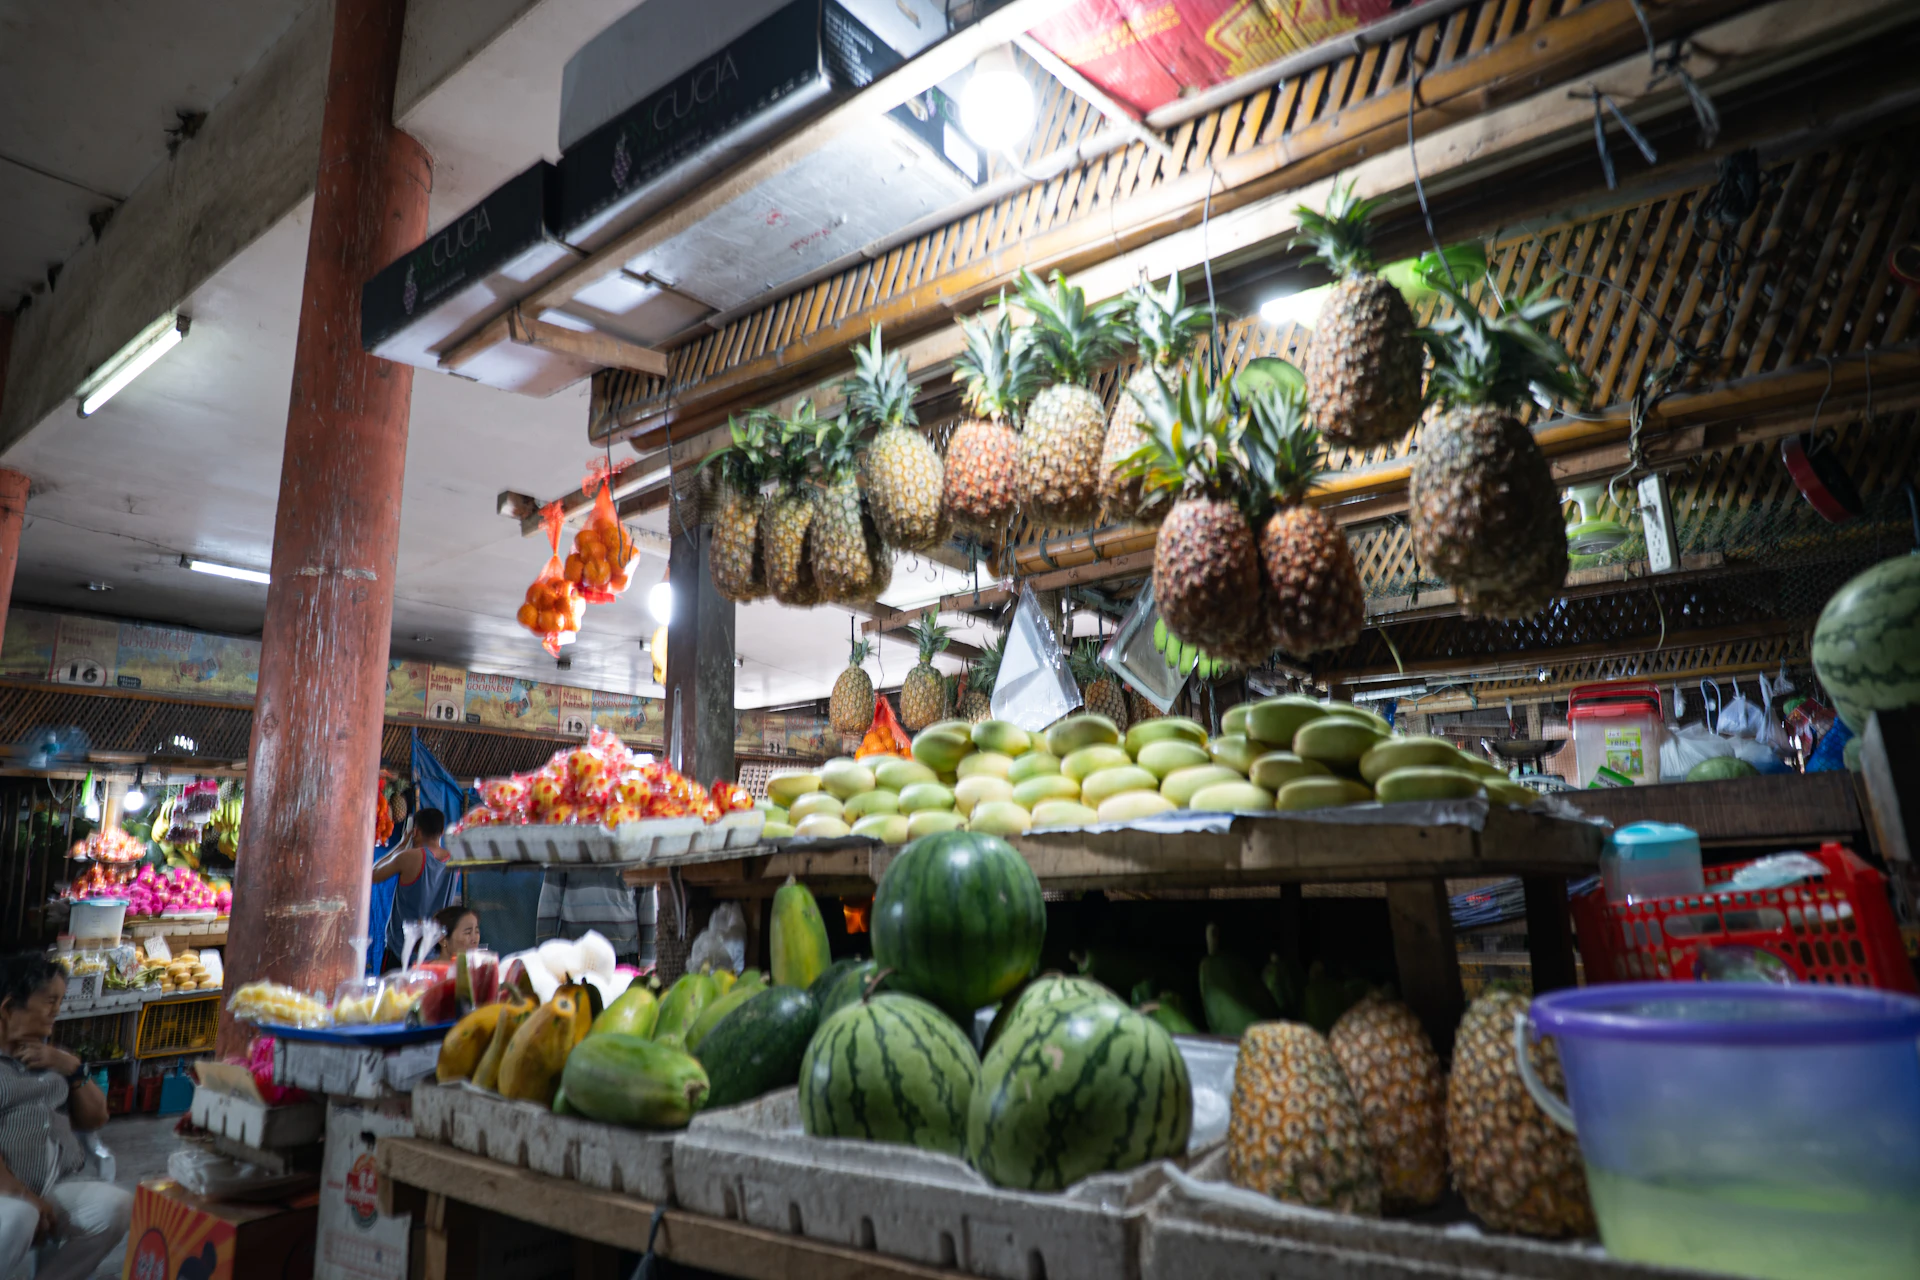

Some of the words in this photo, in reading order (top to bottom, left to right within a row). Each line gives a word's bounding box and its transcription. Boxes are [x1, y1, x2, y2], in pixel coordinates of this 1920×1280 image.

[69, 662, 97, 684] 16
[468, 672, 486, 682] PICK
[467, 683, 512, 693] GOODNESS!
[437, 705, 454, 719] 18
[568, 720, 583, 733] 19
